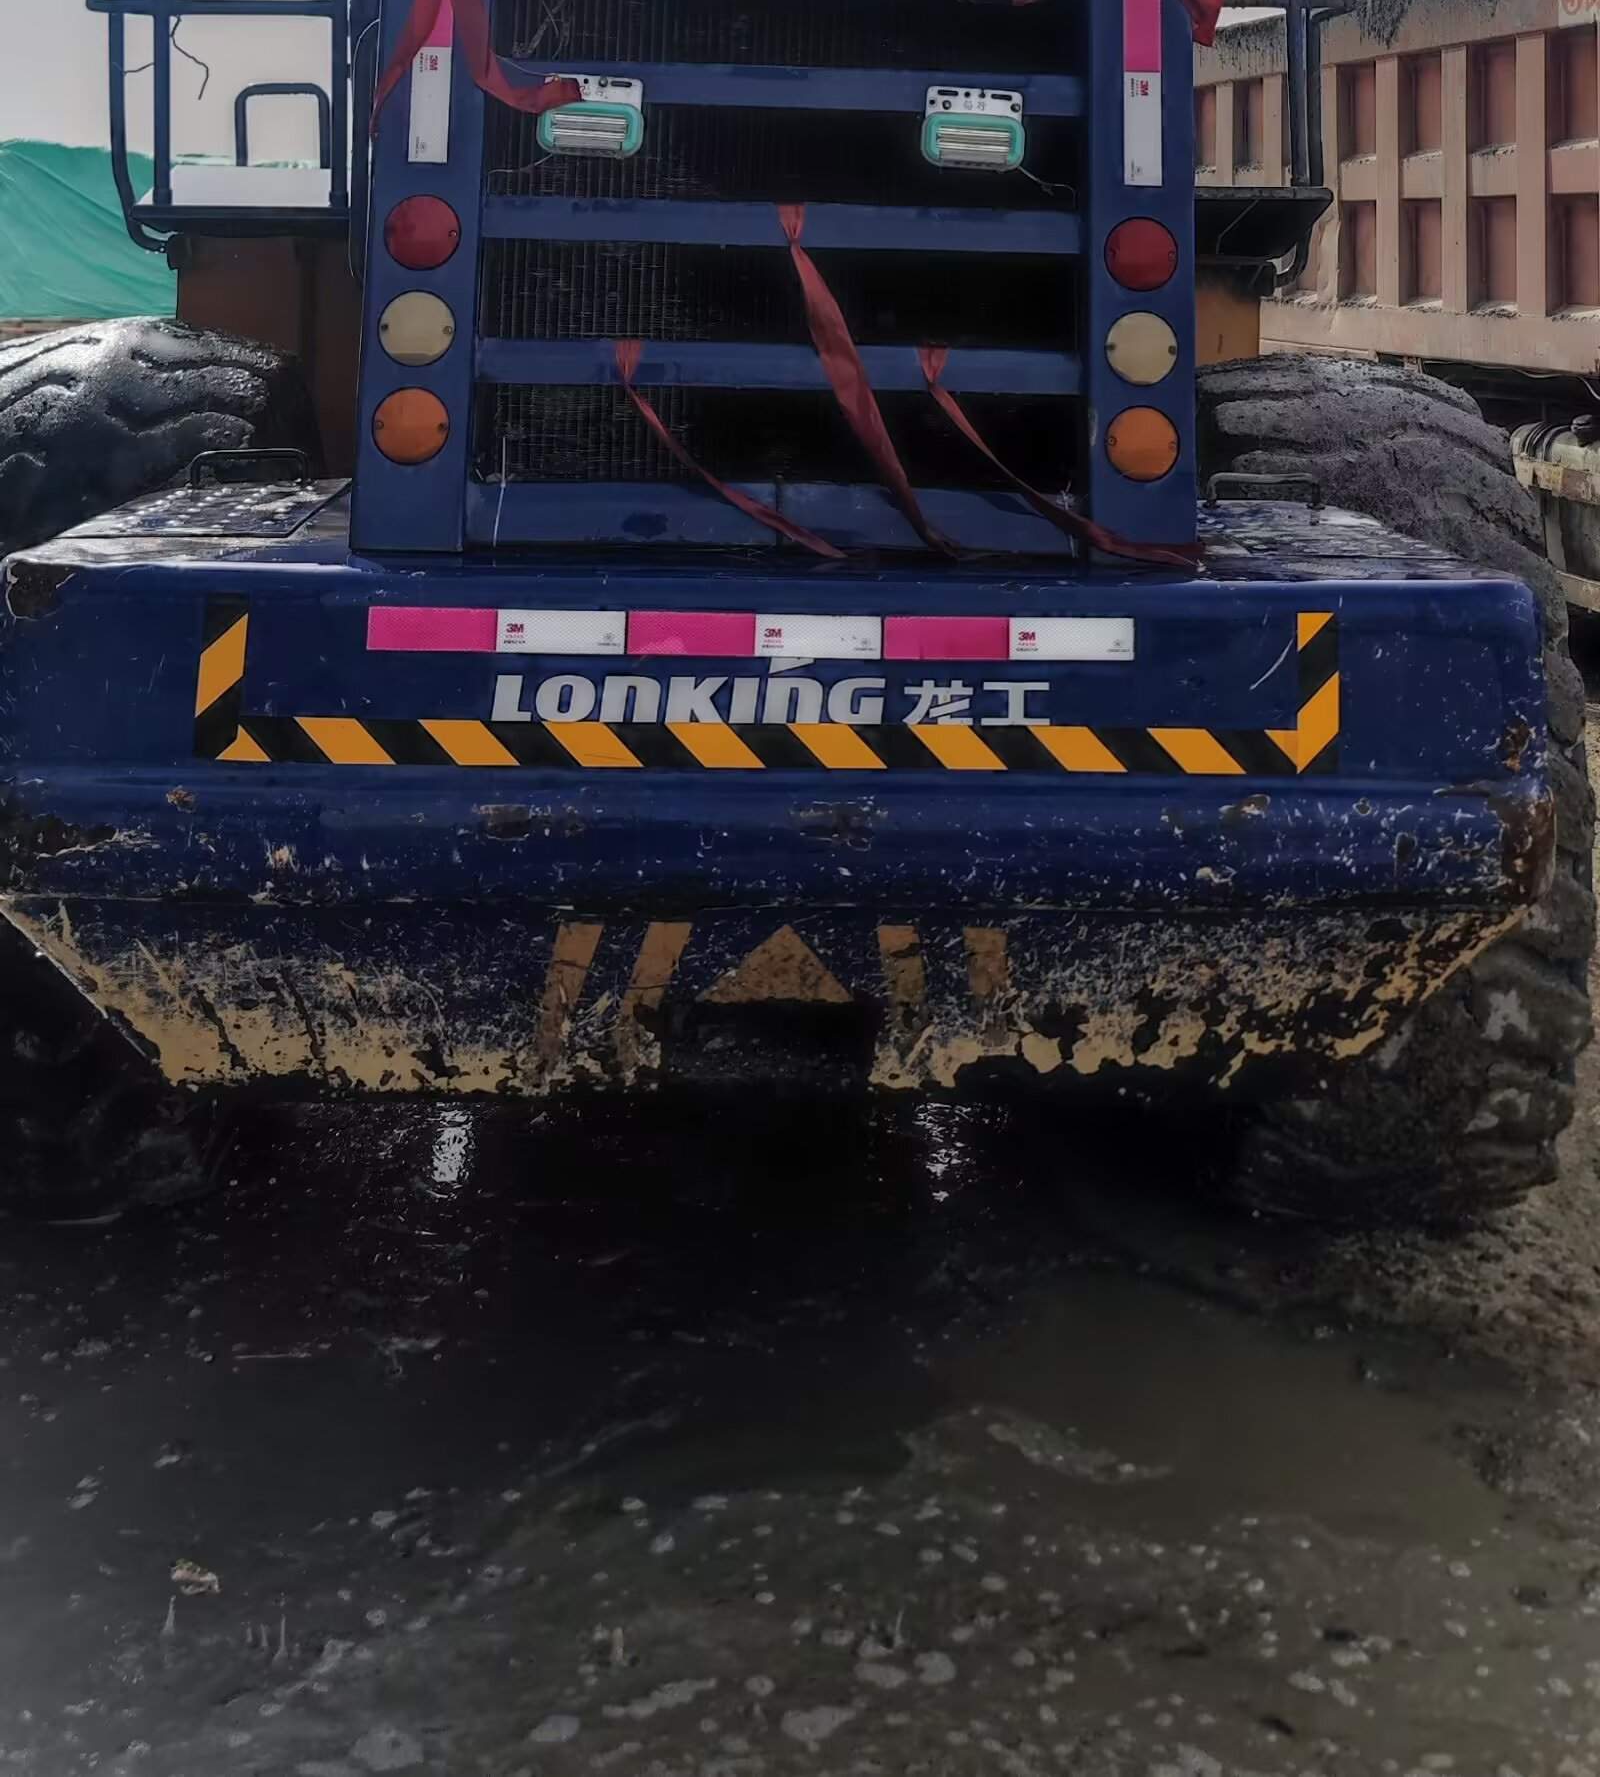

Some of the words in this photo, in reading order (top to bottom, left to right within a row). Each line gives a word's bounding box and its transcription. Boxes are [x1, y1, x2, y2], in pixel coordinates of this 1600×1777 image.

[506, 623, 524, 633] 3M
[764, 628, 782, 638] 3M
[1018, 631, 1036, 642] 3M
[491, 658, 886, 725] LONKING
[903, 679, 1052, 725] 龙工
